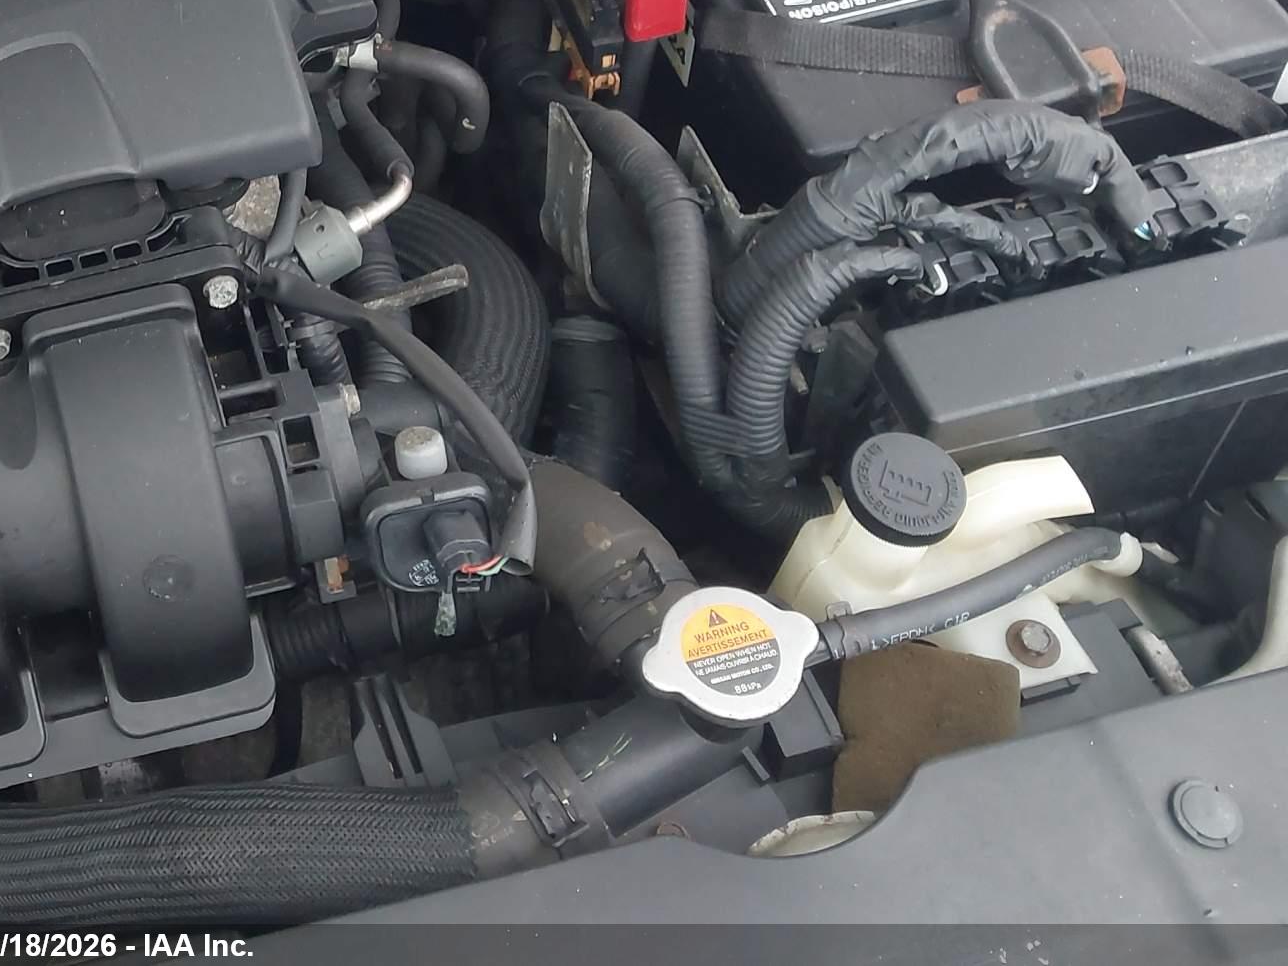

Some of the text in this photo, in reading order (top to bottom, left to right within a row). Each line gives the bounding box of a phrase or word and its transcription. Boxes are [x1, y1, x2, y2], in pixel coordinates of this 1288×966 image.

[688, 629, 768, 658] AVERTISSEMENT
[694, 621, 750, 644] WARNING
[693, 658, 717, 668] NEVER
[716, 654, 735, 665] OPEN
[734, 646, 757, 659] WHEN
